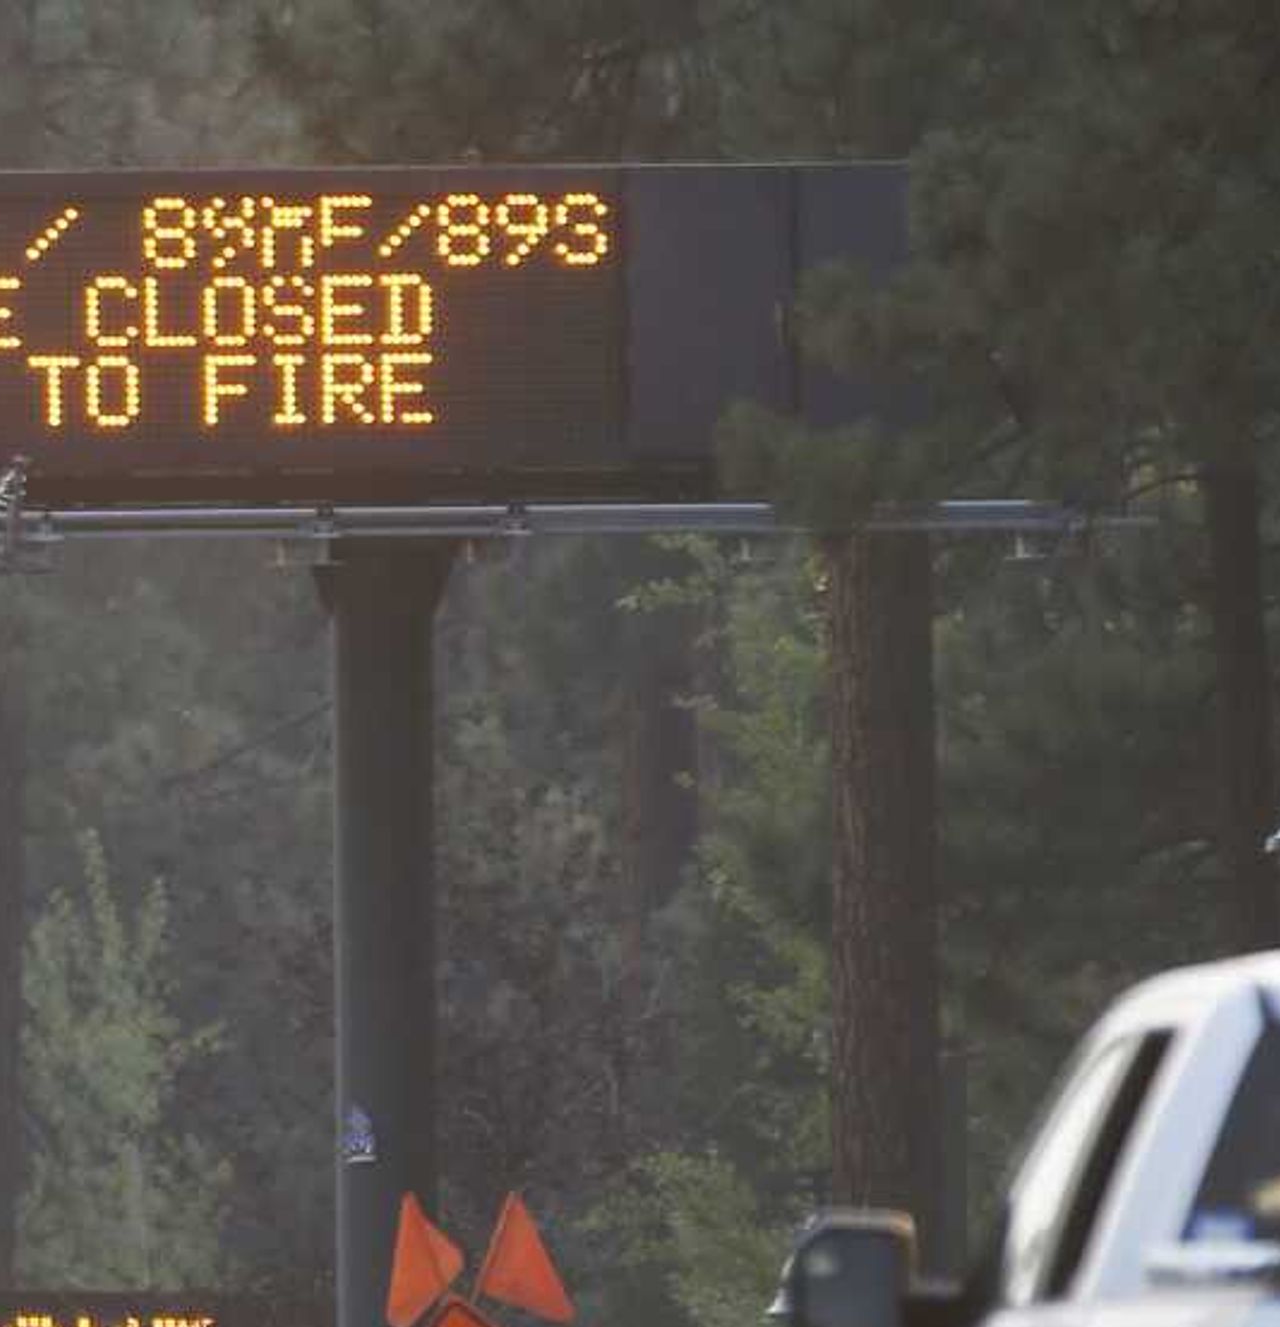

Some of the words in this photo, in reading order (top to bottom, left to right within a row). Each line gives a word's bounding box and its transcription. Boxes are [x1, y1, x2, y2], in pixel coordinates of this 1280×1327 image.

[84, 272, 433, 349] CLOSED
[26, 354, 141, 428] TO
[201, 351, 433, 426] FIRE
